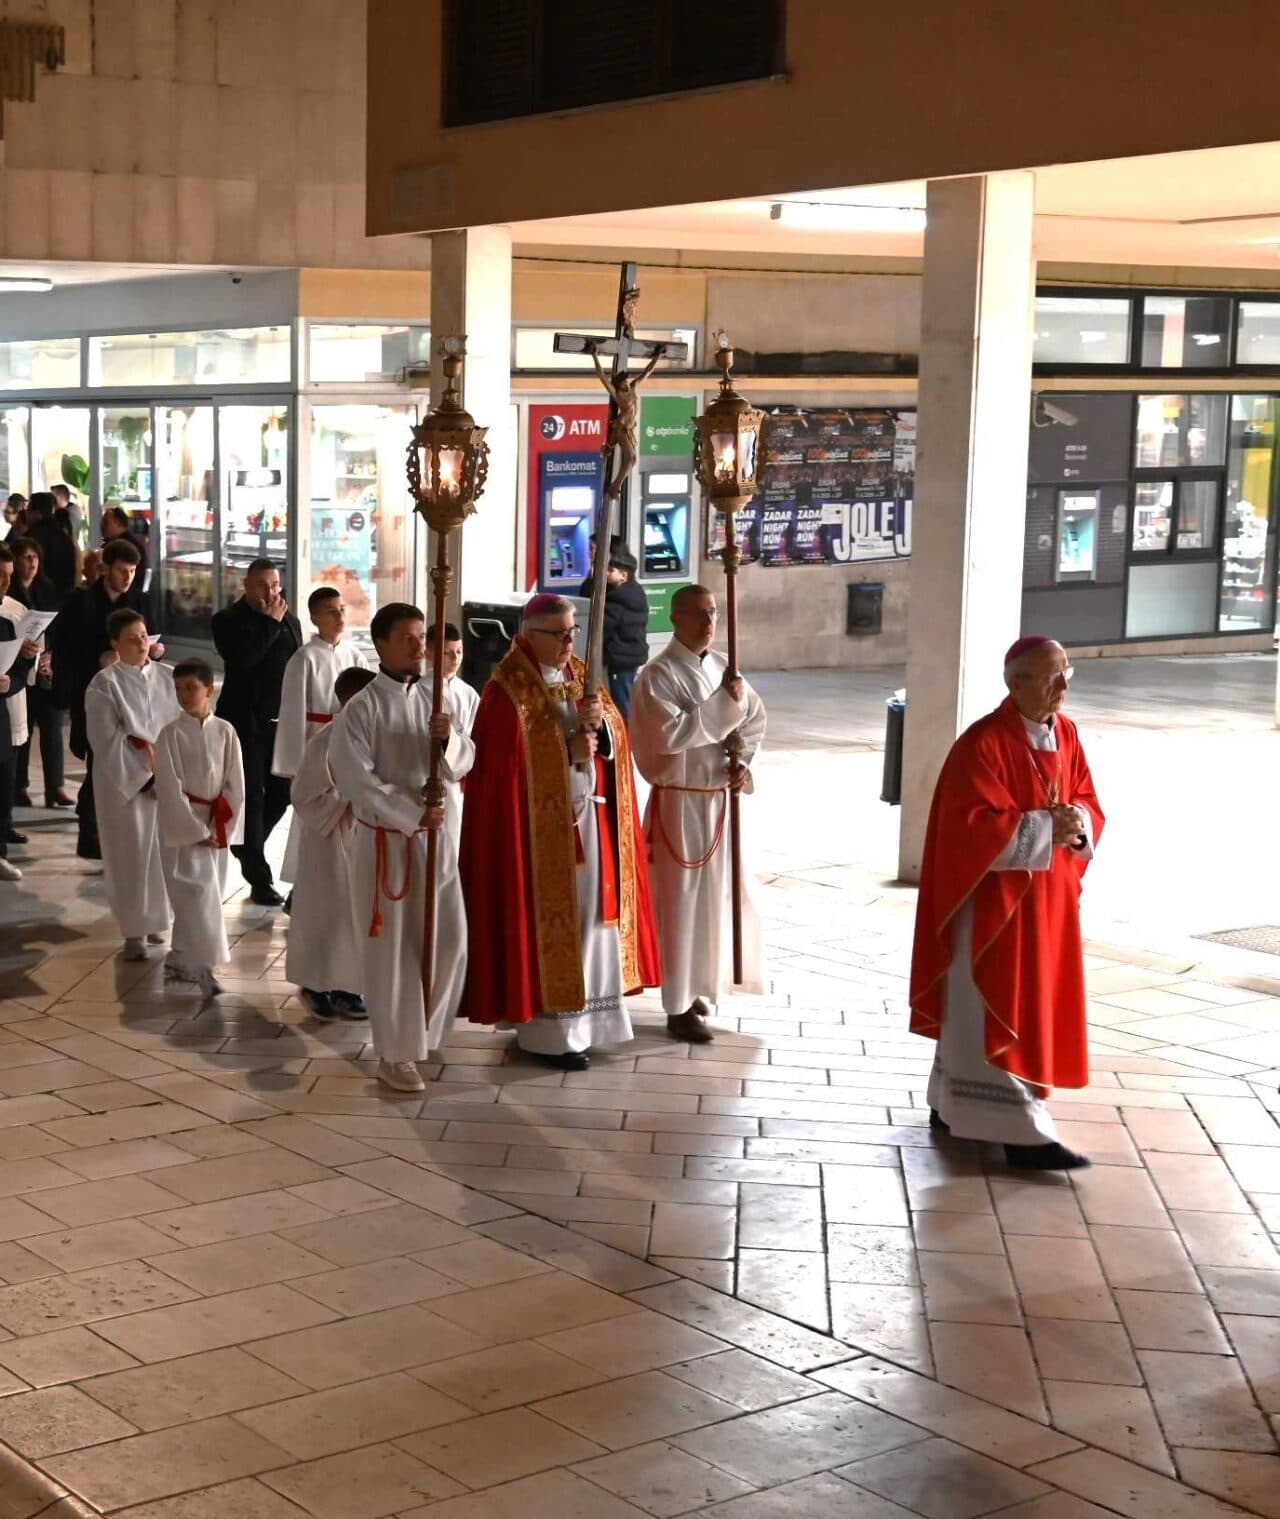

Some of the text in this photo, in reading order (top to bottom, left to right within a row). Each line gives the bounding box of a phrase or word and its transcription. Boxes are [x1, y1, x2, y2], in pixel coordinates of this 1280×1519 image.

[569, 419, 601, 435] ATM
[546, 460, 597, 472] Bankomat
[734, 510, 756, 519] ADAR
[764, 510, 792, 521] ZADAR
[797, 510, 821, 519] ZADA
[764, 522, 789, 533] NIGHT
[832, 502, 894, 560] JOLE
[763, 534, 781, 544] RUN
[797, 532, 815, 542] RUN
